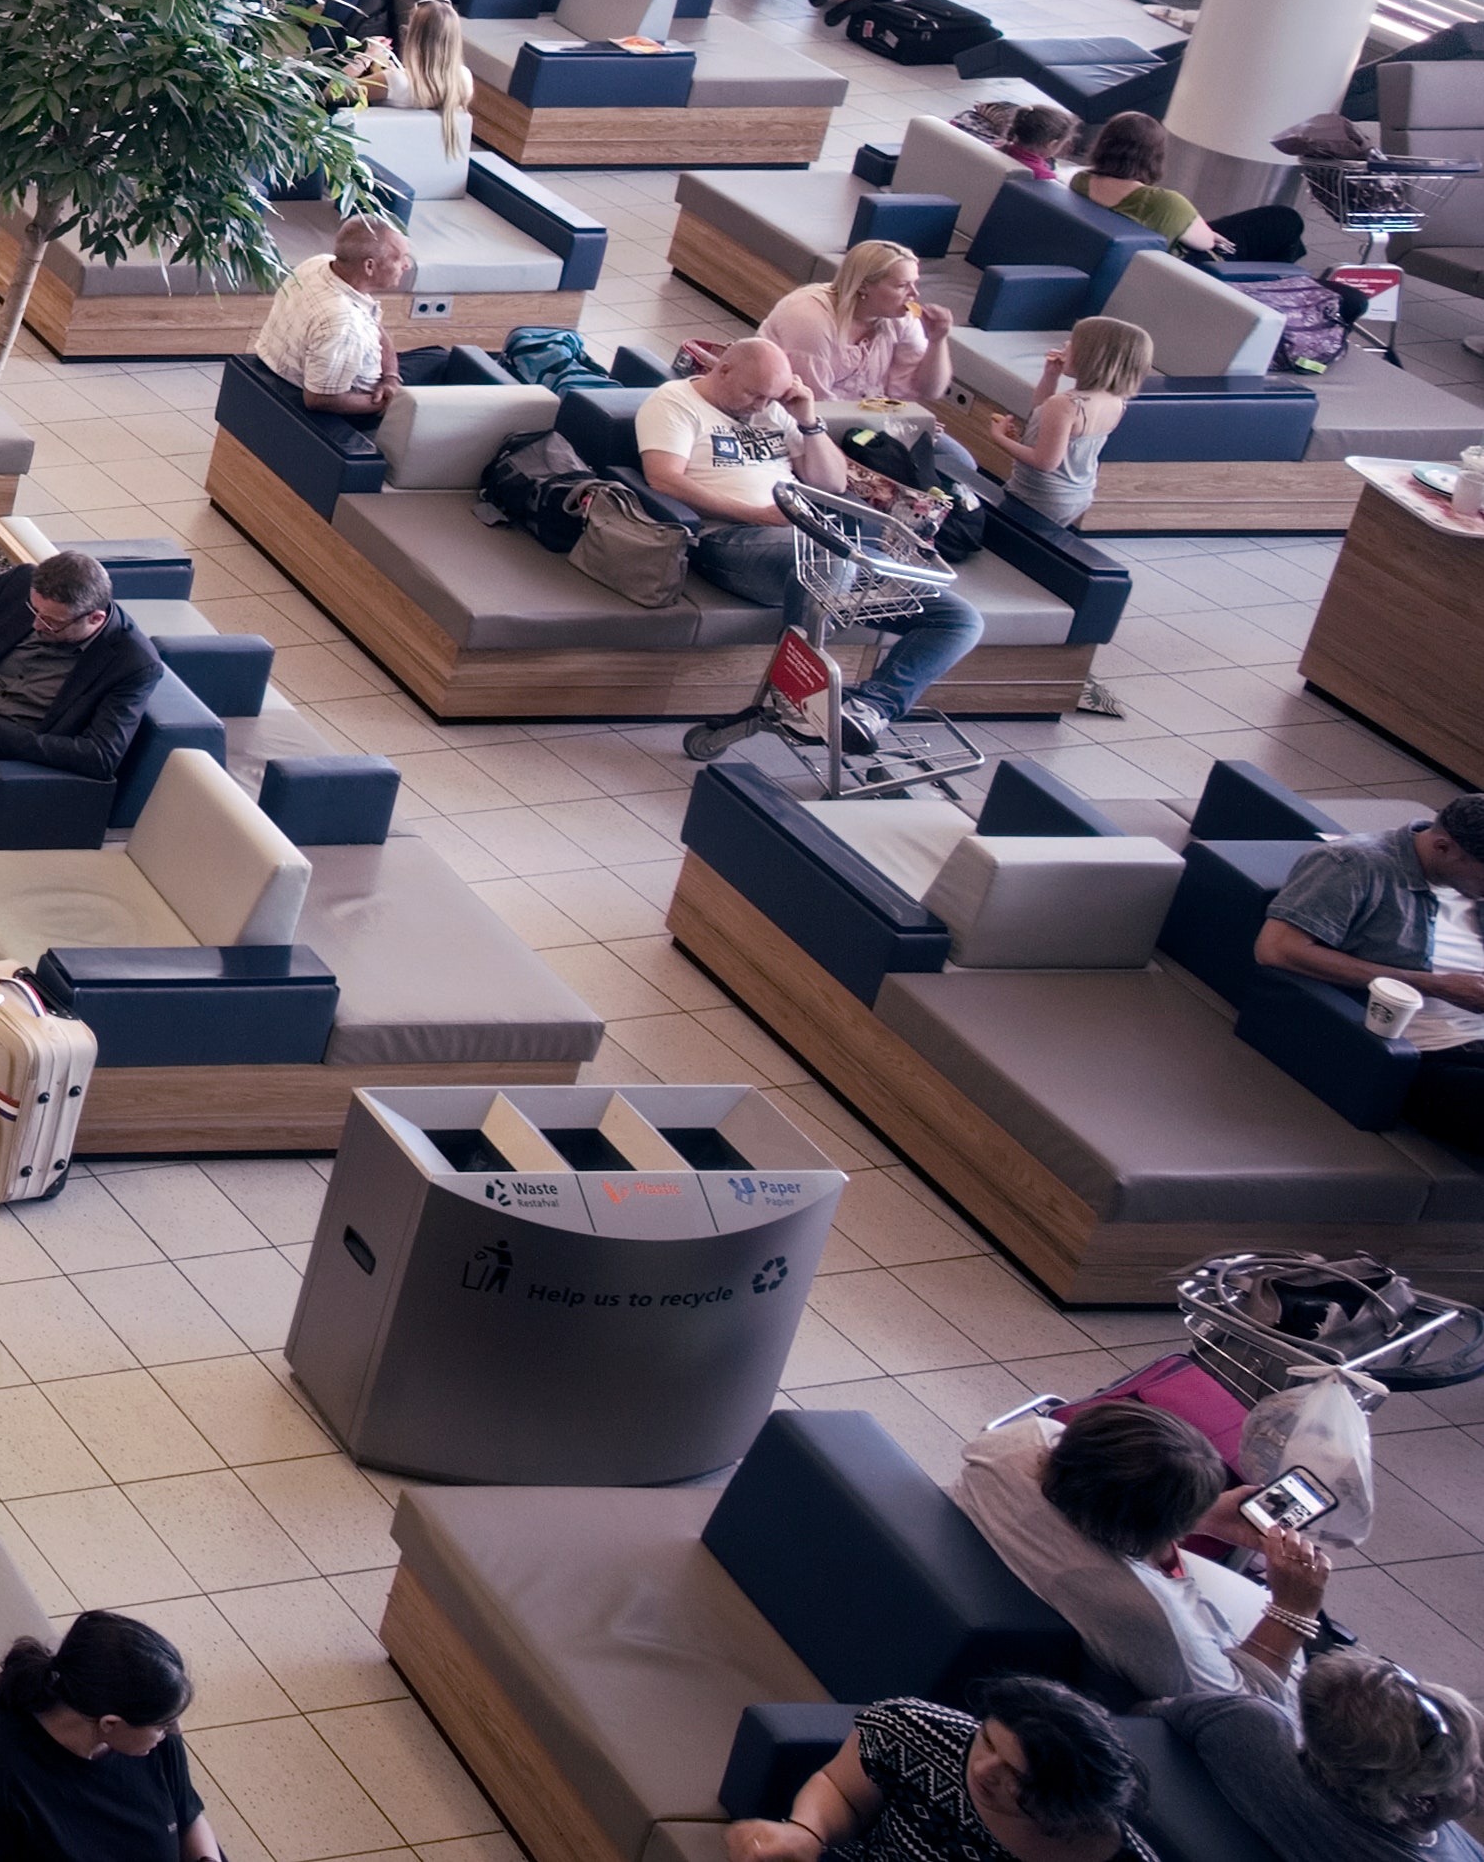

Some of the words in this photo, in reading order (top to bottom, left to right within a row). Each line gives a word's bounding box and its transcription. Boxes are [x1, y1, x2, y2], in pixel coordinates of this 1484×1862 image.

[511, 1182, 558, 1196] Waste
[633, 1182, 681, 1196] Plastic
[759, 1180, 801, 1196] Paper
[517, 1198, 560, 1209] Restafval
[765, 1196, 795, 1208] Papier
[526, 1284, 585, 1308] Help
[593, 1289, 619, 1306] us
[629, 1288, 652, 1307] to
[659, 1286, 734, 1308] recycle
